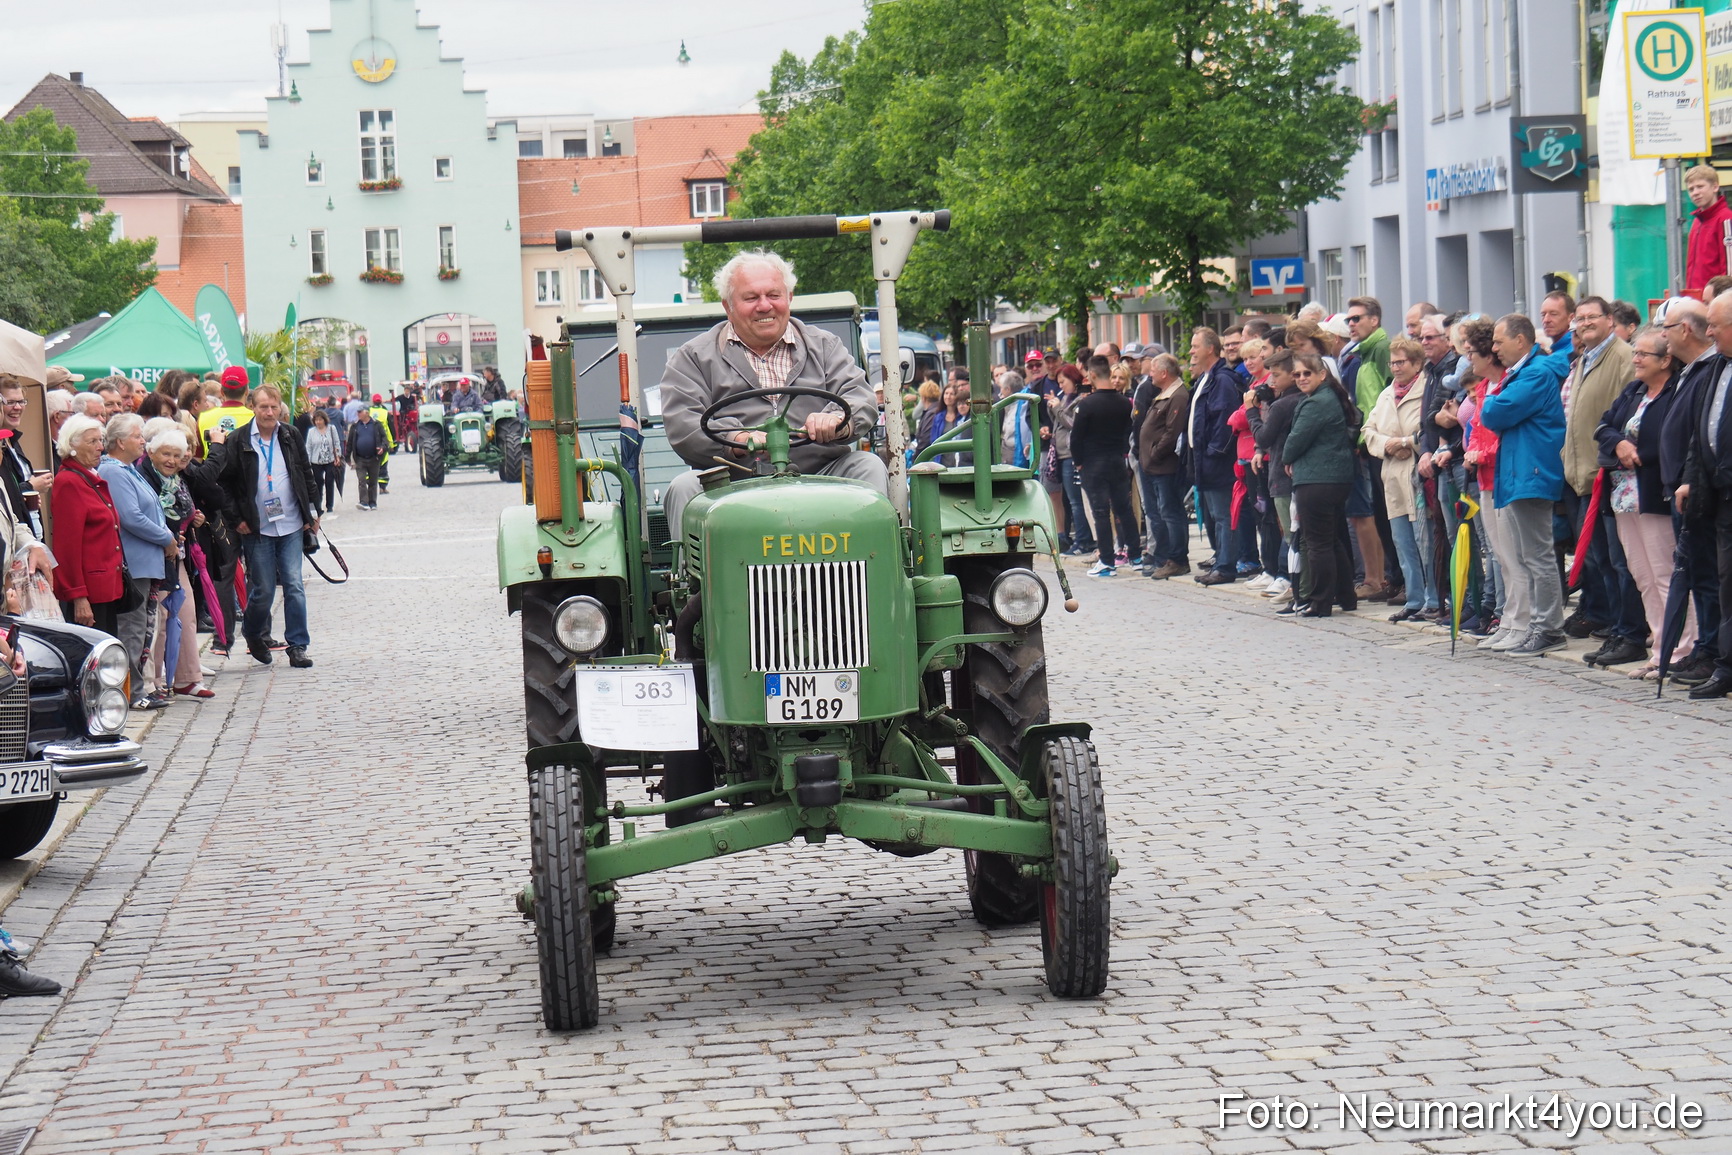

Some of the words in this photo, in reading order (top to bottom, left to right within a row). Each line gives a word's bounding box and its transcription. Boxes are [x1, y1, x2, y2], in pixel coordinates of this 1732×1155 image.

[1652, 34, 1677, 68] H
[1647, 90, 1687, 99] Rathaus
[762, 532, 851, 557] FENDT
[634, 681, 673, 699] 363
[770, 687, 777, 695] D
[786, 676, 816, 697] NM
[11, 768, 49, 795] 272H
